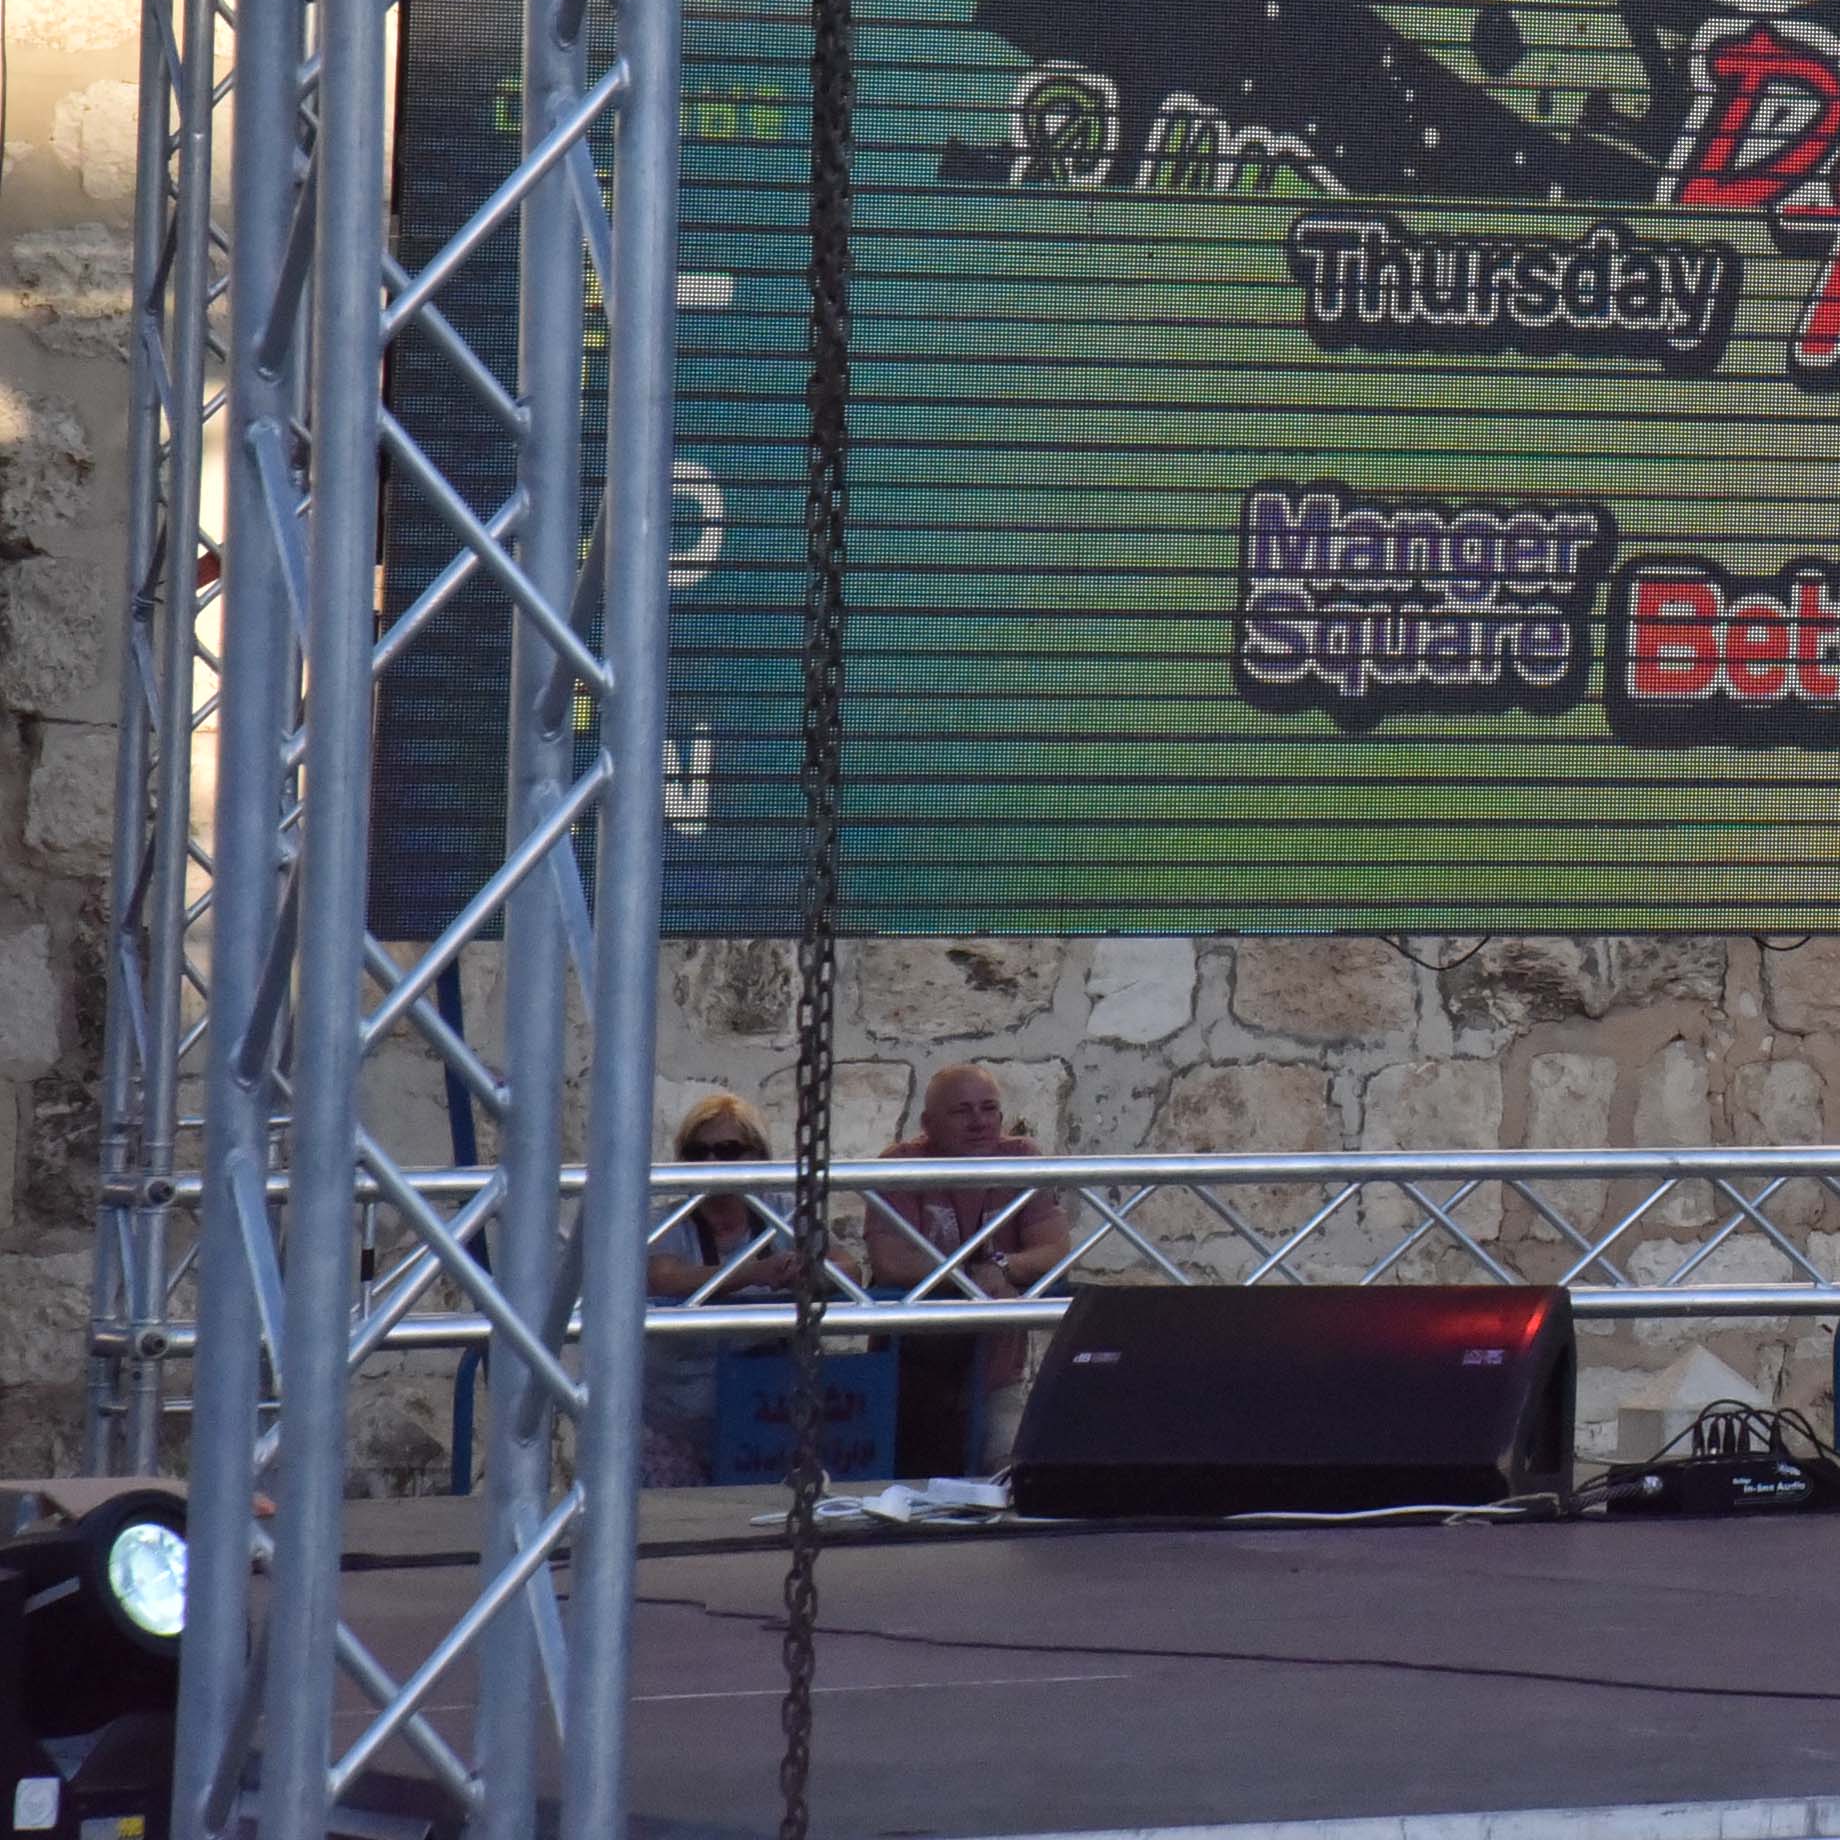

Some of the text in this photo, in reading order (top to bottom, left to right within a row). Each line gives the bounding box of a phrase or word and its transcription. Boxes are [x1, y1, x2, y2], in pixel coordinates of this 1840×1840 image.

[1292, 211, 1725, 350] Thursday
[1247, 492, 1599, 600] Manger
[1241, 580, 1571, 697] Square
